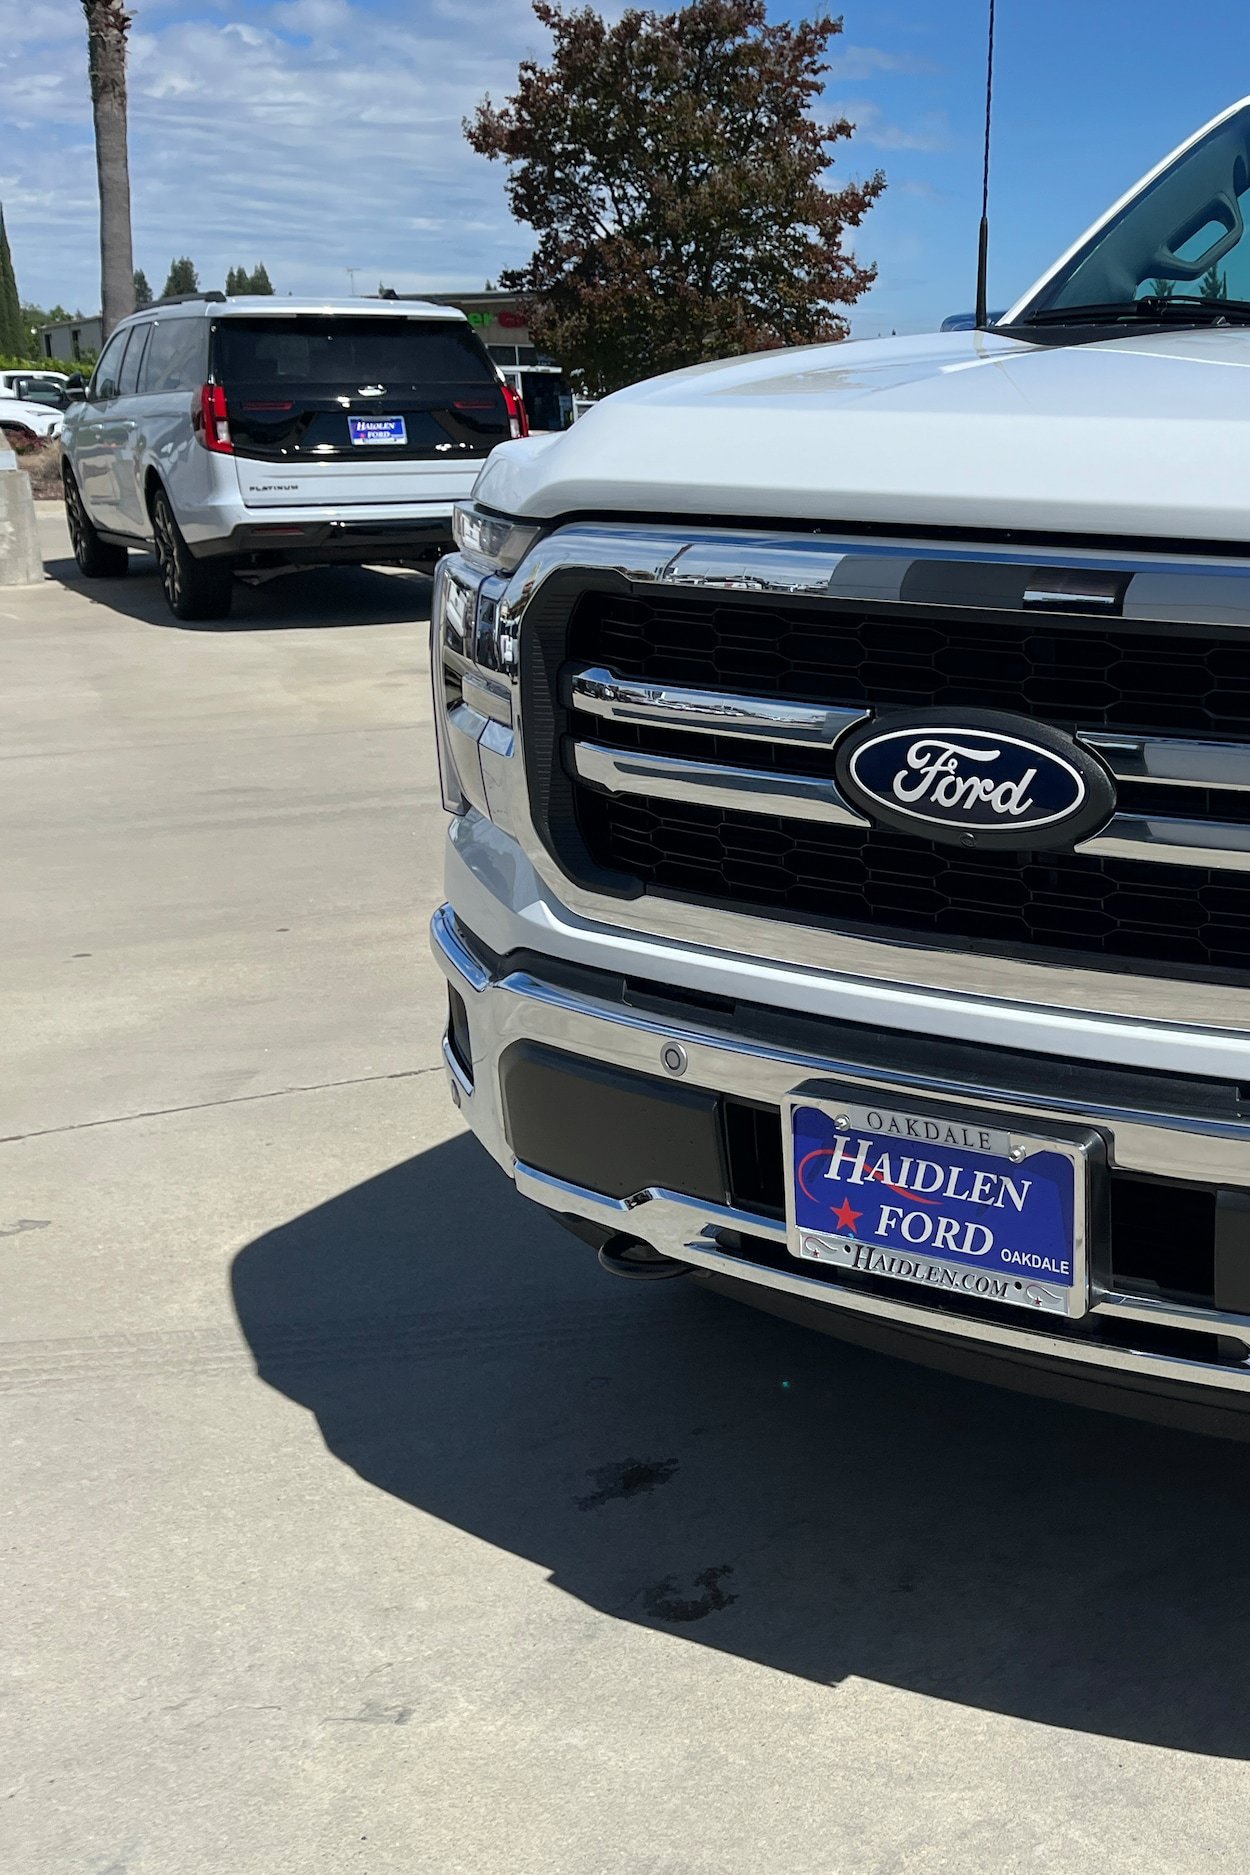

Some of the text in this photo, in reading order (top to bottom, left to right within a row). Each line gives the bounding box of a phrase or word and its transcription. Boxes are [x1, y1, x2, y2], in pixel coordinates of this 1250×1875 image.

[356, 421, 395, 431] HAIDLEN
[367, 430, 391, 439] FORD
[893, 739, 1037, 815] Ford
[866, 1111, 991, 1150] OAKDALE
[824, 1134, 1032, 1212] HAIDLEN
[875, 1204, 994, 1256] FORD
[852, 1244, 1009, 1298] HAIDLEN.COM
[1001, 1248, 1070, 1275] OAKDALE
